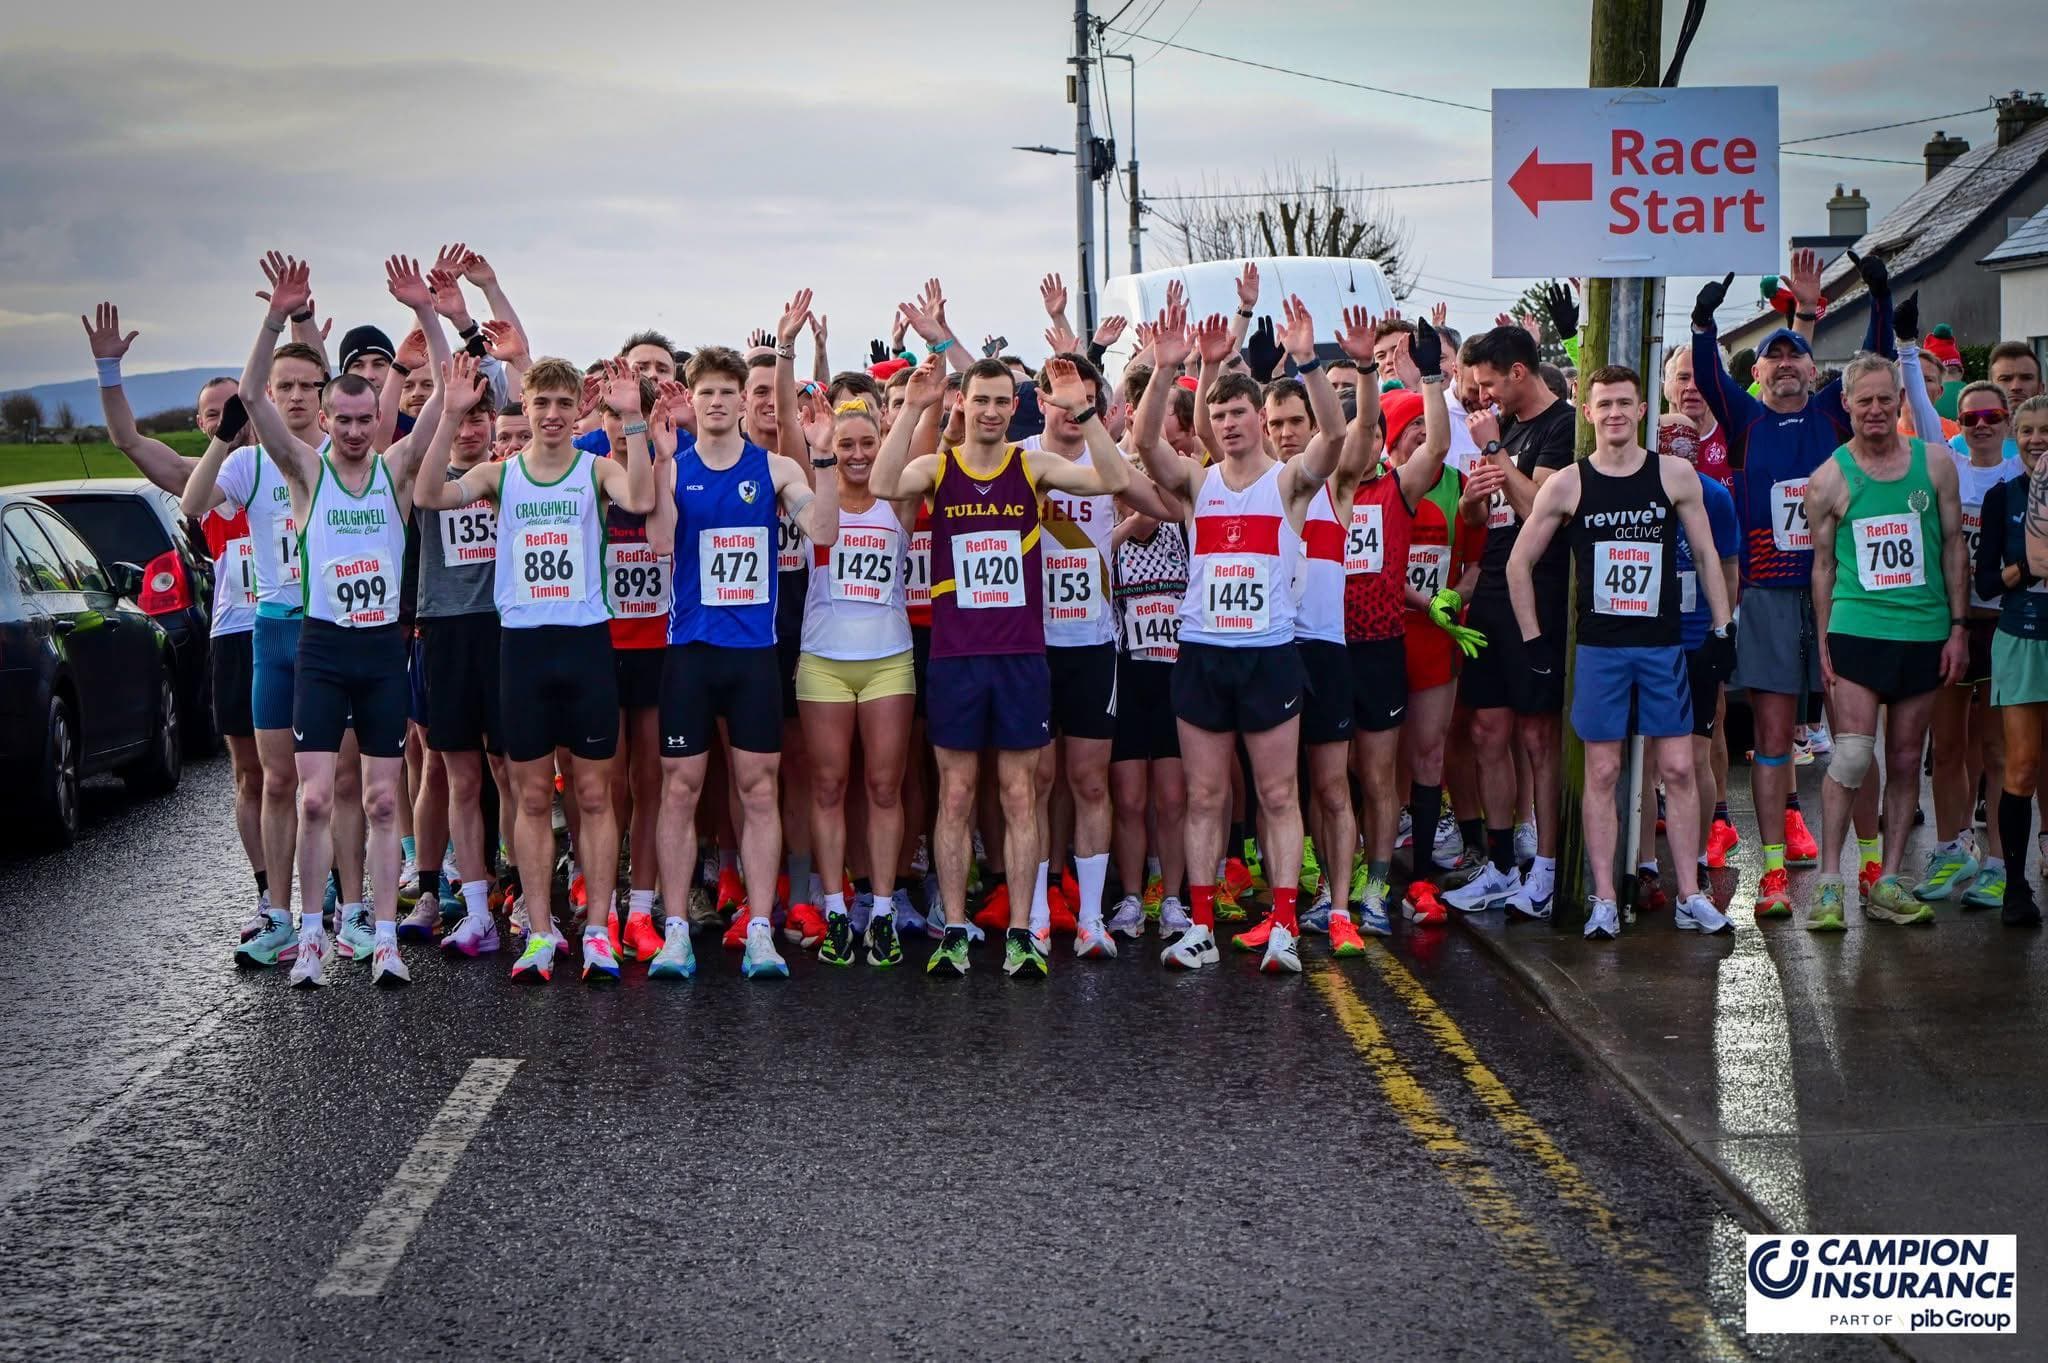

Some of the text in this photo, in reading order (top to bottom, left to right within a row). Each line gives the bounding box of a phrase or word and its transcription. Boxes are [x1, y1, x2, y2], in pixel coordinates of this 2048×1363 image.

[1612, 129, 1757, 175] Race
[1609, 186, 1765, 234] Start
[327, 509, 387, 525] CRAUGHWELL
[515, 500, 579, 519] CRAUGHWELL
[945, 503, 1025, 518] TULLA AC
[1584, 510, 1654, 529] revive
[1615, 525, 1660, 539] active
[1866, 523, 1908, 537] RedTag
[525, 532, 568, 546] RedTag
[713, 535, 755, 548] RedTag
[844, 534, 886, 549] RedTag
[966, 538, 1008, 553] RedTag
[1347, 527, 1379, 555] 54
[457, 545, 496, 560] Timing
[617, 550, 658, 563] RedTag
[1608, 548, 1650, 562] RedTag
[1867, 538, 1915, 571] 708
[335, 560, 379, 577] RedTag
[524, 550, 574, 583] 886
[710, 552, 758, 583] 472
[837, 552, 893, 583] 1425
[1046, 557, 1087, 570] RedTag
[962, 556, 1019, 588] 1420
[1215, 565, 1254, 578] RedTag
[614, 566, 662, 597] 893
[1406, 567, 1442, 598] 94
[1604, 565, 1653, 594] 487
[1874, 573, 1912, 586] Timing
[337, 576, 386, 612] 999
[530, 584, 570, 598] Timing
[716, 587, 754, 600] Timing
[844, 584, 880, 600] Timing
[1049, 572, 1091, 603] 153
[972, 590, 1009, 604] Timing
[1209, 583, 1264, 611] 1445
[1610, 597, 1648, 612] Timing
[620, 601, 657, 613] Timing
[1050, 606, 1087, 619] Timing
[1136, 602, 1174, 616] RedTag
[1215, 615, 1253, 629] Timing
